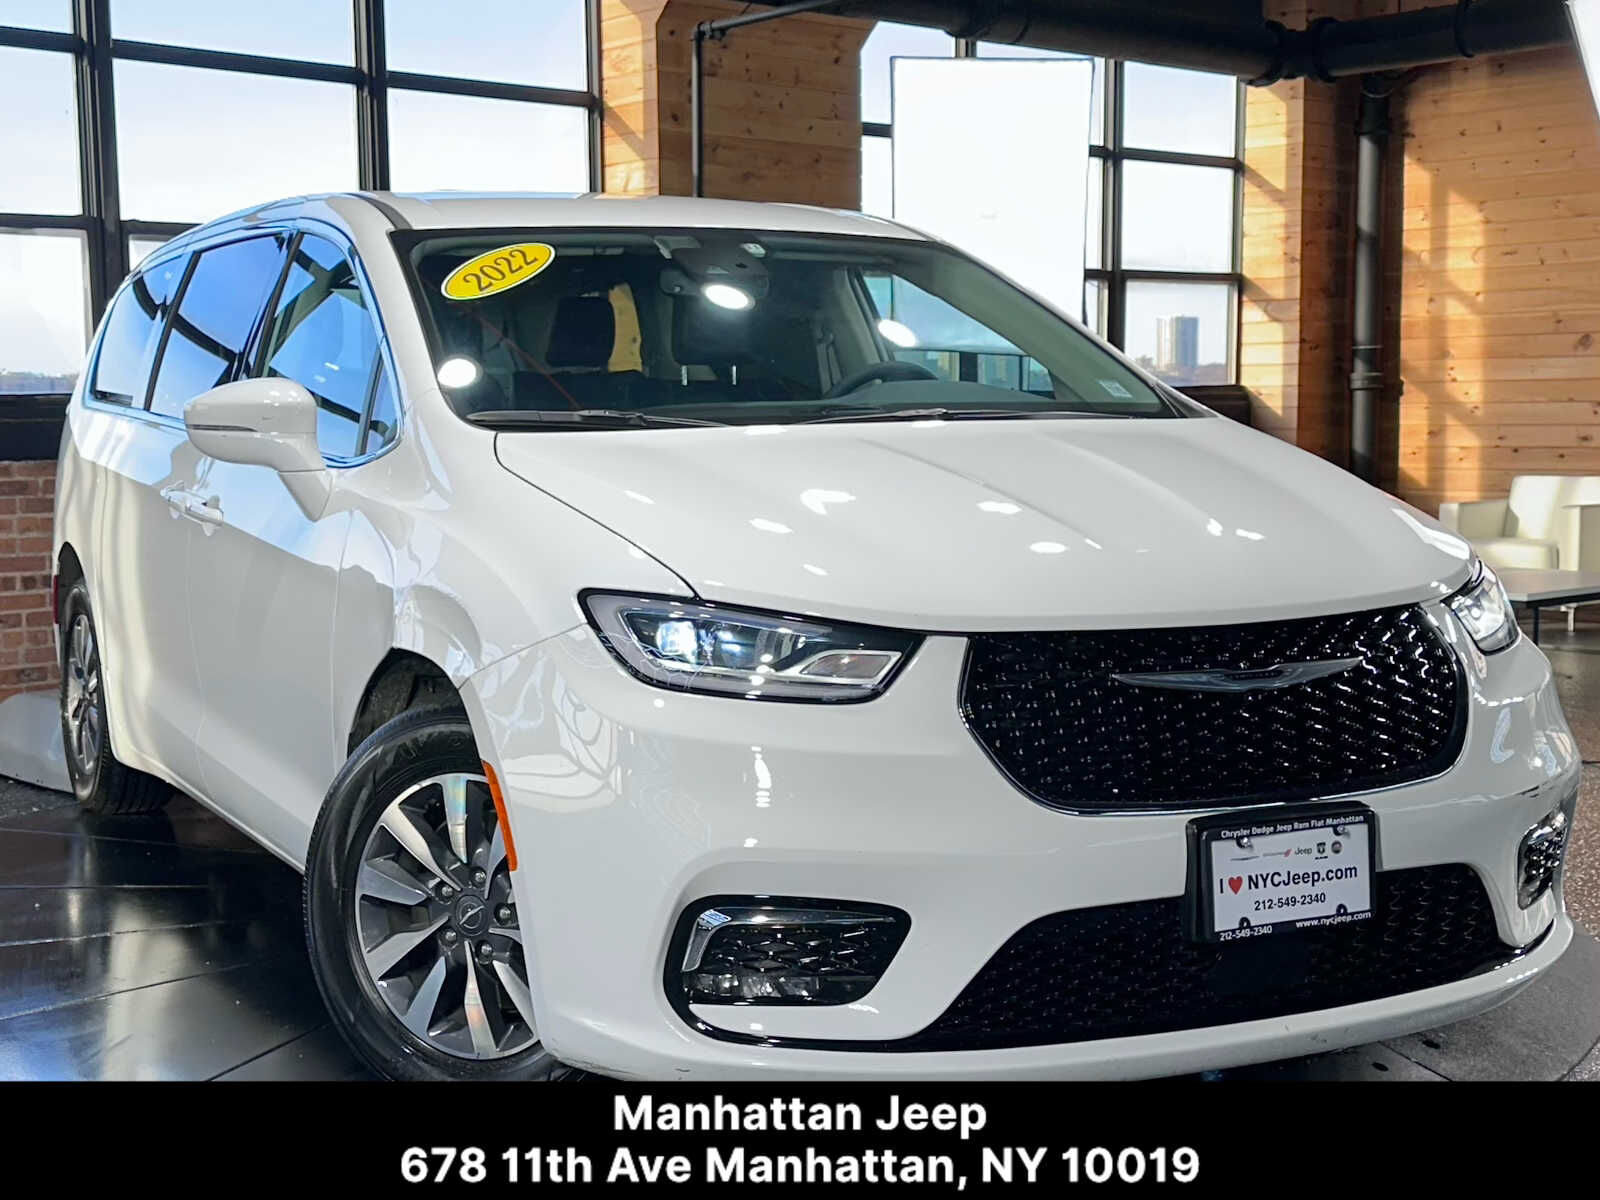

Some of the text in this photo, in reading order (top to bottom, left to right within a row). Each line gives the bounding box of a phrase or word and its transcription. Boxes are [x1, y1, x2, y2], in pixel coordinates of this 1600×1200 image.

[463, 249, 539, 292] 2022
[1221, 815, 1364, 839] Chrysler Dodge Jeep Ram Fiat Manhattan
[1294, 846, 1312, 855] Jeep
[1219, 866, 1358, 894] I NYCJeep.com
[1254, 893, 1326, 911] 212-549-2340
[1296, 911, 1371, 928] www.nycjeep.com
[1220, 925, 1272, 941] 212-549-2340
